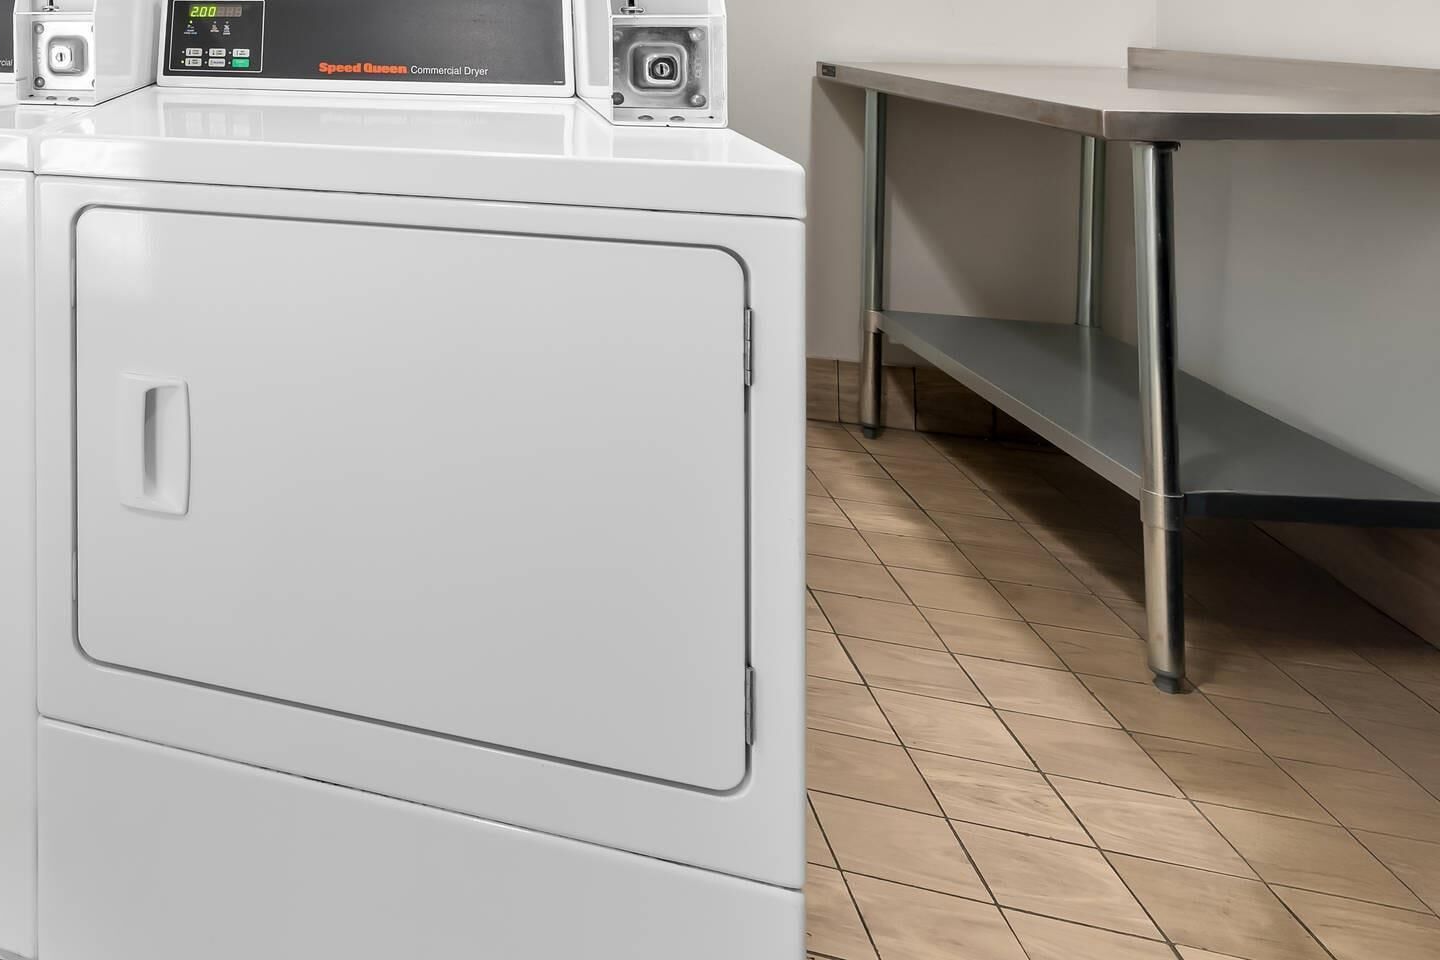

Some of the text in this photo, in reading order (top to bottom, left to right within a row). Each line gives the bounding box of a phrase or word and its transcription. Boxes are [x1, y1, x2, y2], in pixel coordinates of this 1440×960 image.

[190, 6, 216, 18] 2.00
[318, 62, 489, 76] Speed Queen Commercial Dryer
